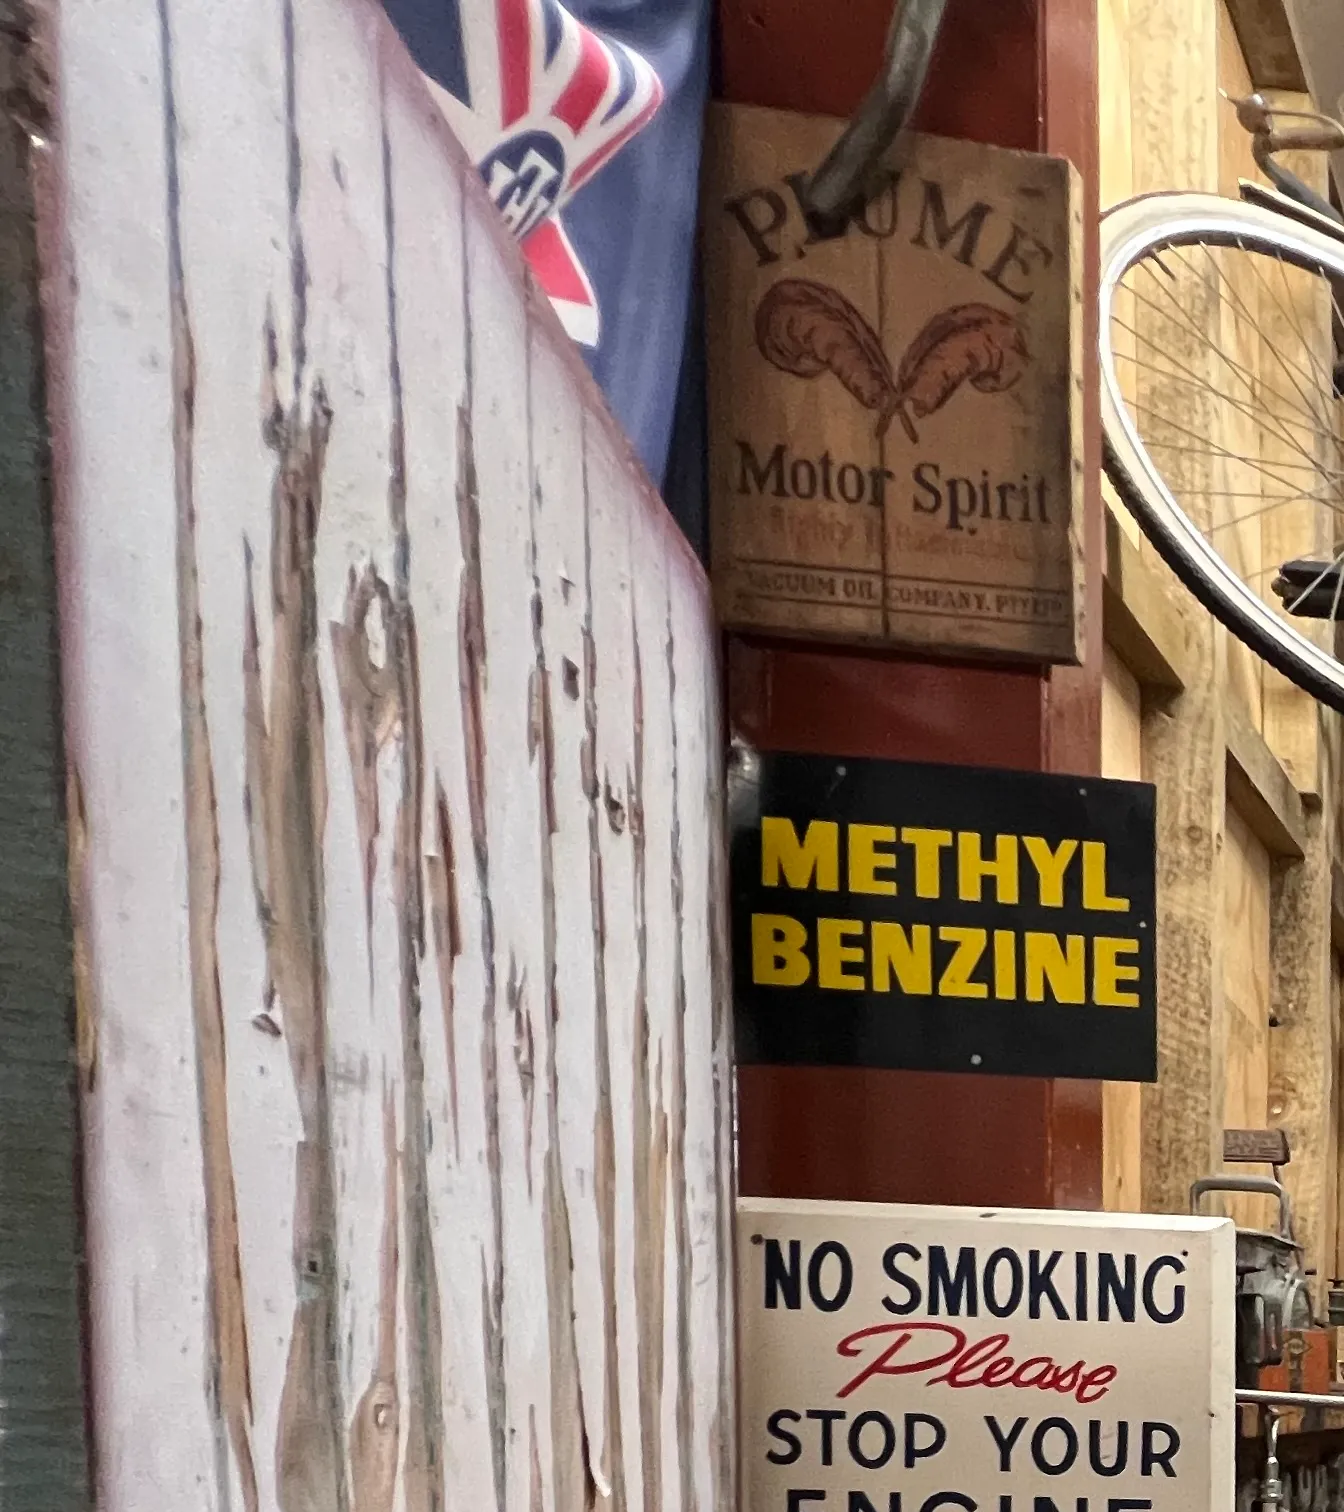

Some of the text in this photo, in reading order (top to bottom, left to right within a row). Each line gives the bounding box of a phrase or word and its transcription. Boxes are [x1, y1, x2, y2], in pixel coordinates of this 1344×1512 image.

[736, 441, 1051, 535] Motor Spirit
[760, 817, 1131, 913] METHYL
[751, 913, 1141, 1008] BENZINE
[763, 1239, 1187, 1324] NO SMOKING
[836, 1322, 1118, 1404] Please
[766, 1409, 1182, 1479] STOP YOUR
